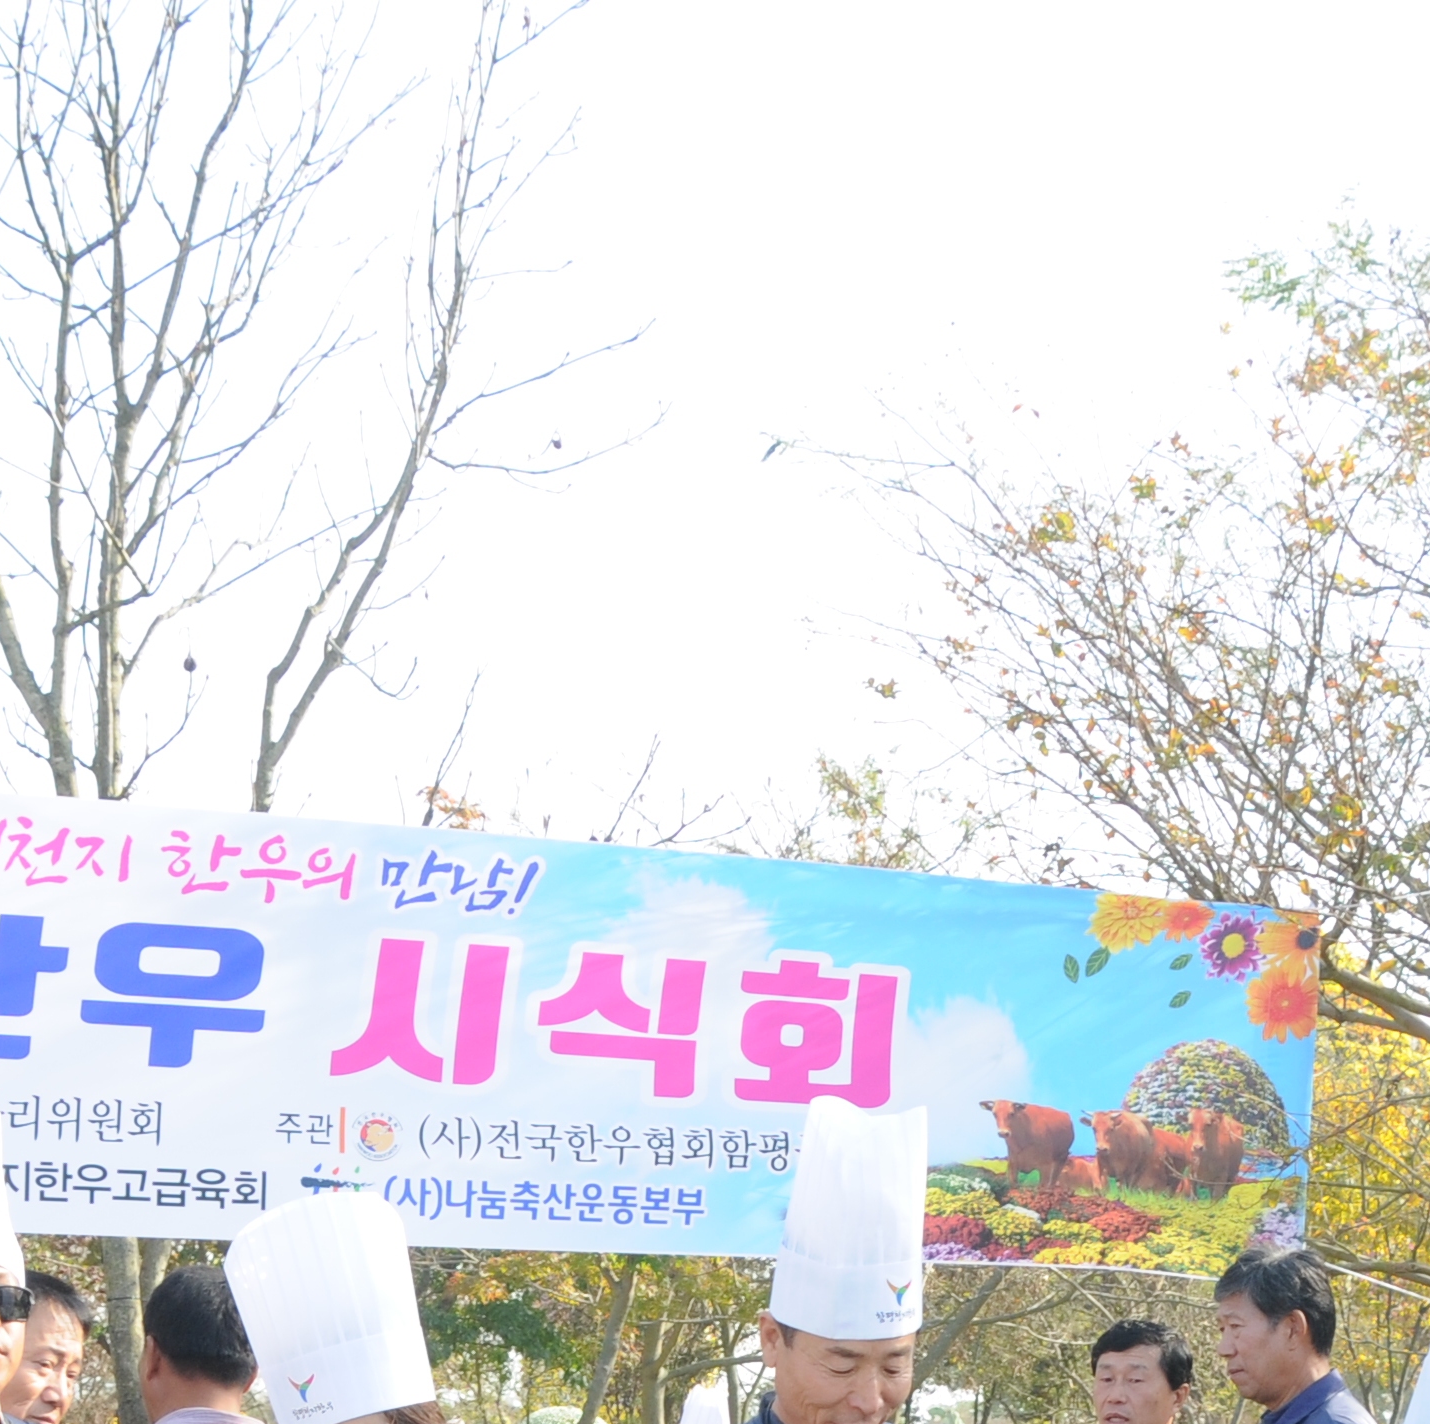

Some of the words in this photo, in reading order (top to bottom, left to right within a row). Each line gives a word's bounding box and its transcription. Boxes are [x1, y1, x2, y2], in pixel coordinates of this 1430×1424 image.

[160, 830, 356, 904] 한우의
[380, 849, 540, 916] 만남!
[329, 937, 899, 1108] 시식회
[275, 1112, 334, 1145] 주관
[418, 1114, 805, 1171] (사)전국한우협회함평
[384, 1175, 705, 1226] (사)나눔축산운동본부
